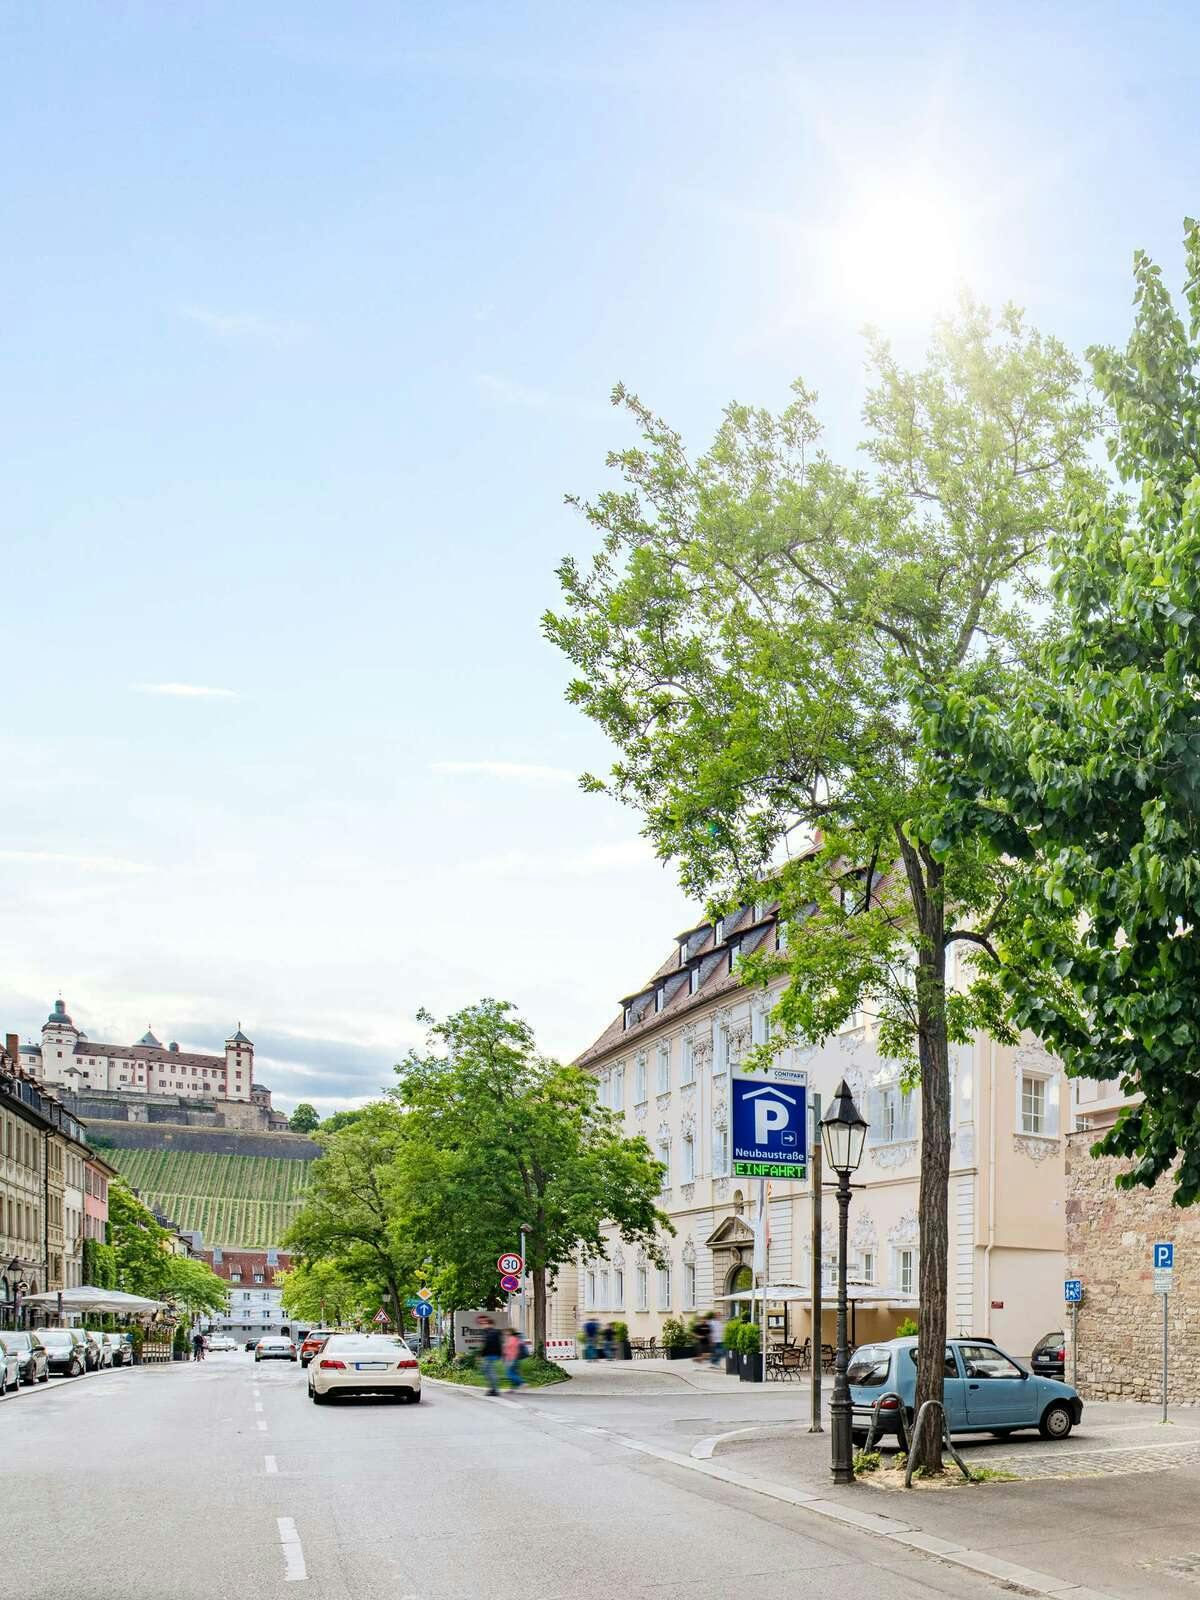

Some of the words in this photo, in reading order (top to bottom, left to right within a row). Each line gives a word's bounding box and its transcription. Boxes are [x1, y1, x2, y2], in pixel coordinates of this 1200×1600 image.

[774, 1070, 805, 1079] CONTIPARK
[754, 1099, 789, 1145] P
[735, 1148, 805, 1161] Neubaustraße
[735, 1163, 804, 1177] EINFAHRT
[1158, 1247, 1169, 1266] P
[503, 1259, 518, 1270] 30
